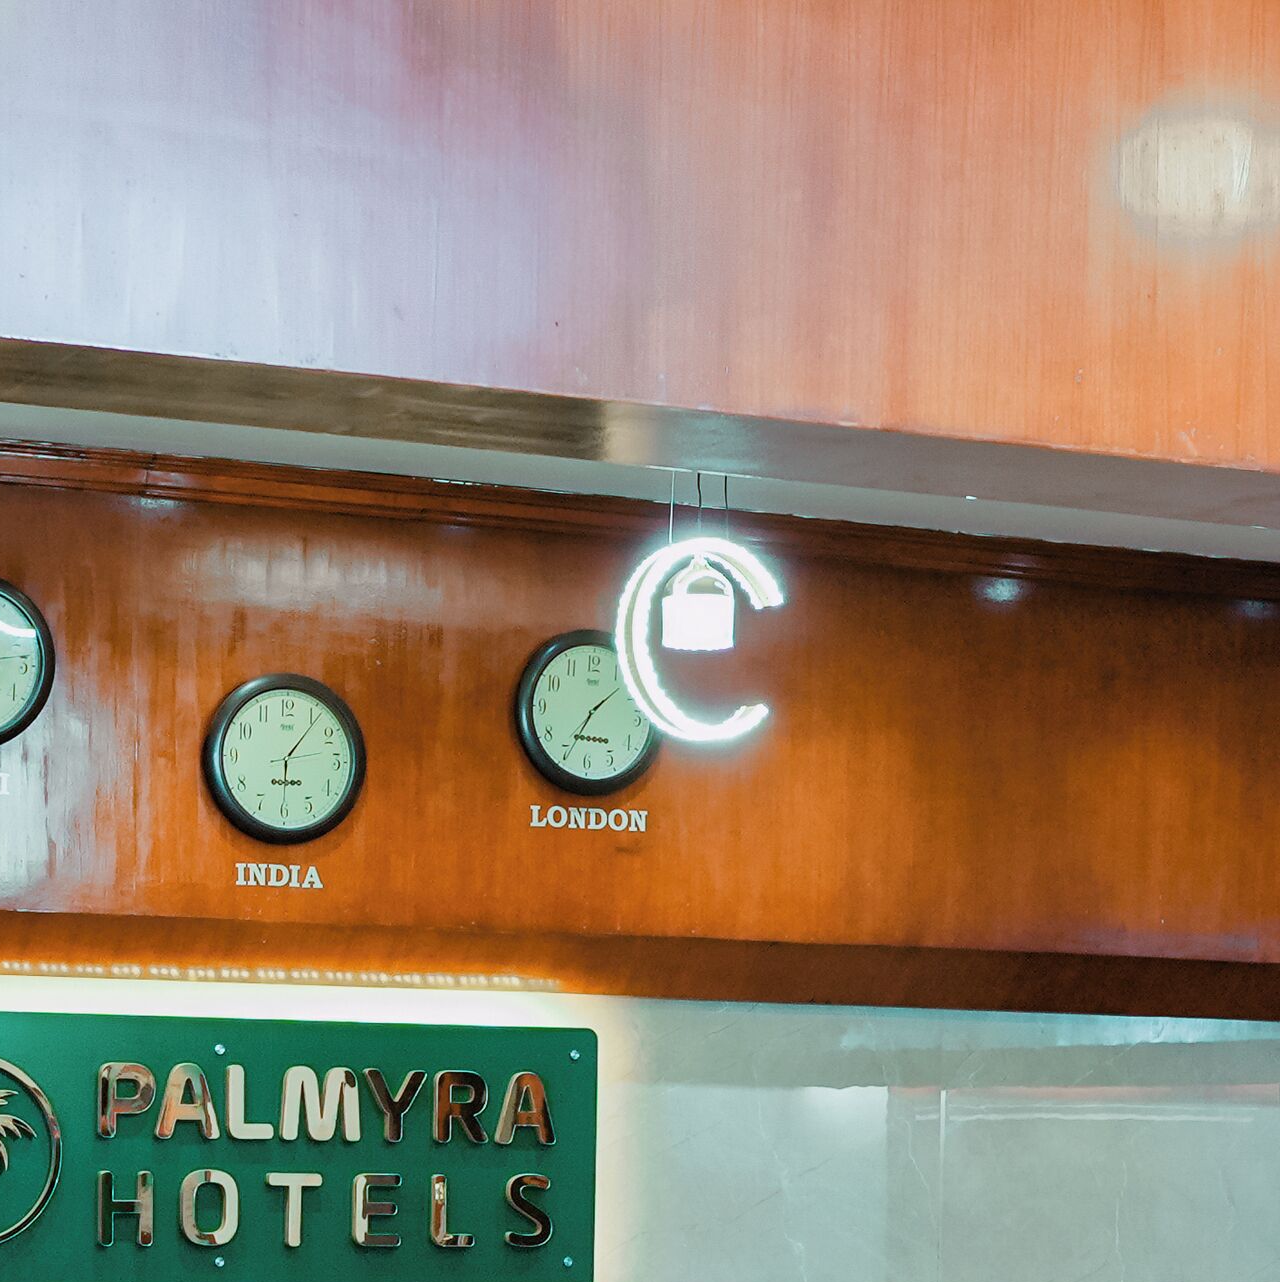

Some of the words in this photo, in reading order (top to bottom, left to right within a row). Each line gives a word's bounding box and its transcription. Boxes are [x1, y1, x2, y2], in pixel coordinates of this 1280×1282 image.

[566, 658, 576, 677] 11
[587, 654, 601, 673] 12
[547, 674, 560, 692] 10
[258, 705, 268, 723] 11
[281, 698, 295, 717] 12
[538, 698, 547, 714] 9
[239, 722, 252, 740] 10
[544, 726, 553, 741] 8
[229, 747, 239, 764] 9
[582, 753, 592, 769] 6
[606, 750, 614, 767] 5
[236, 775, 247, 792] 8
[256, 793, 265, 811] 7
[280, 802, 289, 818] 6
[304, 796, 313, 814] 5
[529, 804, 648, 832] LONDON
[234, 863, 323, 889] INDIA
[96, 1061, 556, 1146] PALMYRA
[96, 1169, 553, 1248] HOTELS
